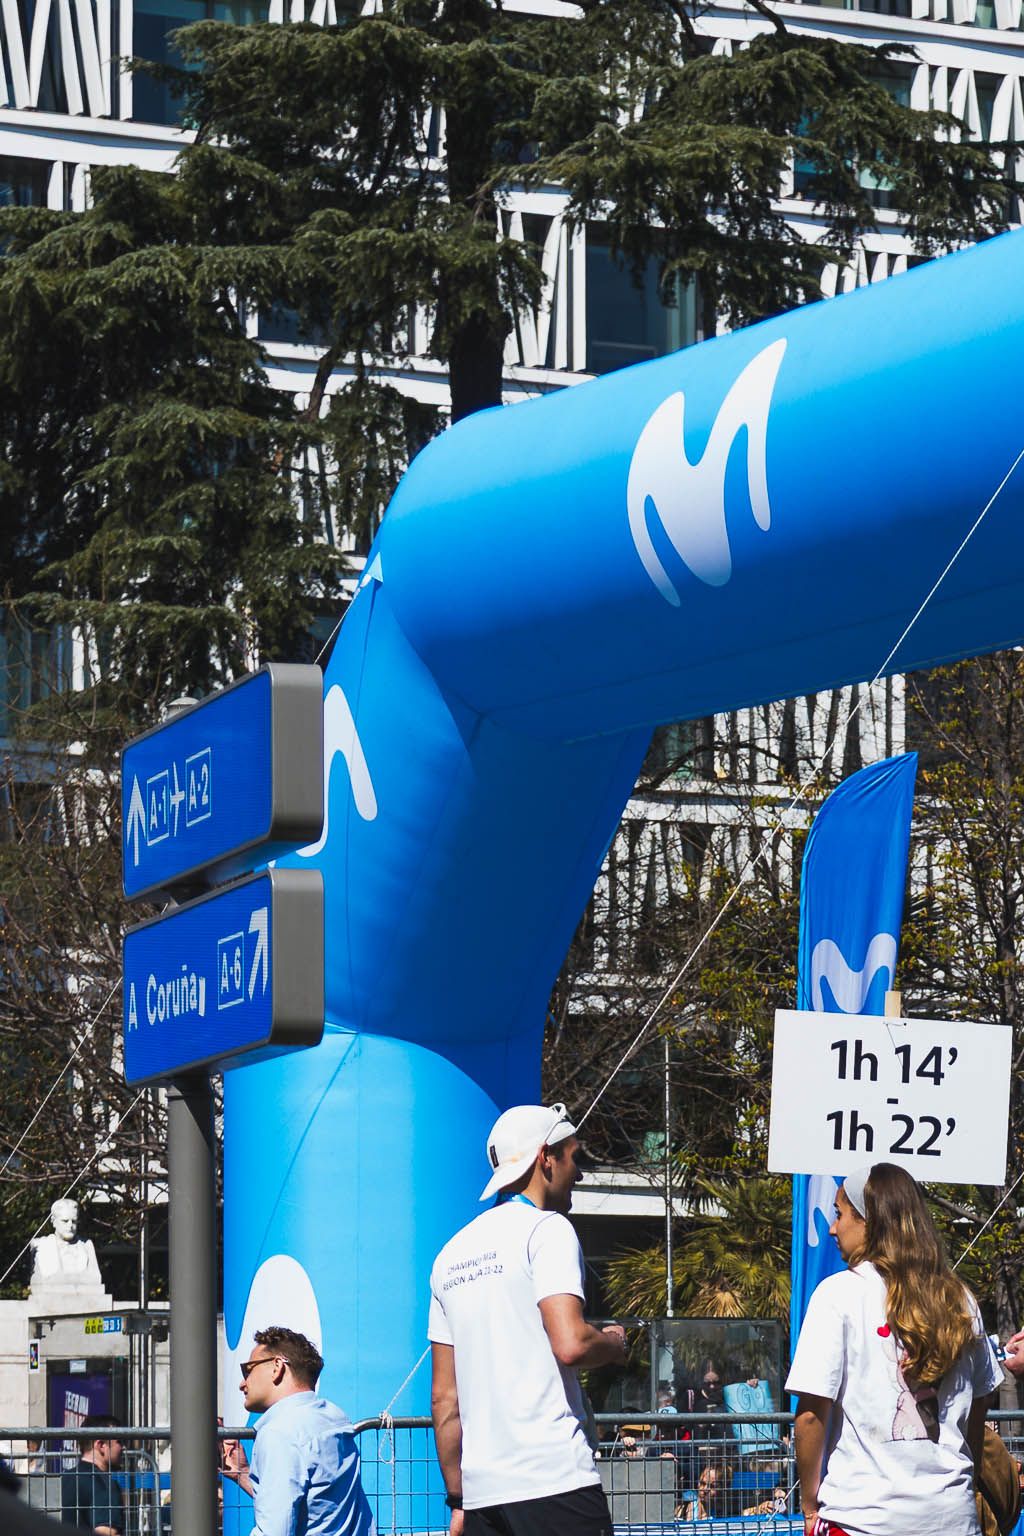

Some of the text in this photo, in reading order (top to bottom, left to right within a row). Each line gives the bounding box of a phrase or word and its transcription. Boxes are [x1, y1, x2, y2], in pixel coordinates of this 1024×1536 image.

[150, 762, 209, 831] A-1 A-2
[128, 946, 242, 1032] A Coruña A-6
[830, 1039, 959, 1086] 1h 14’
[826, 1110, 956, 1157] 1h 22’
